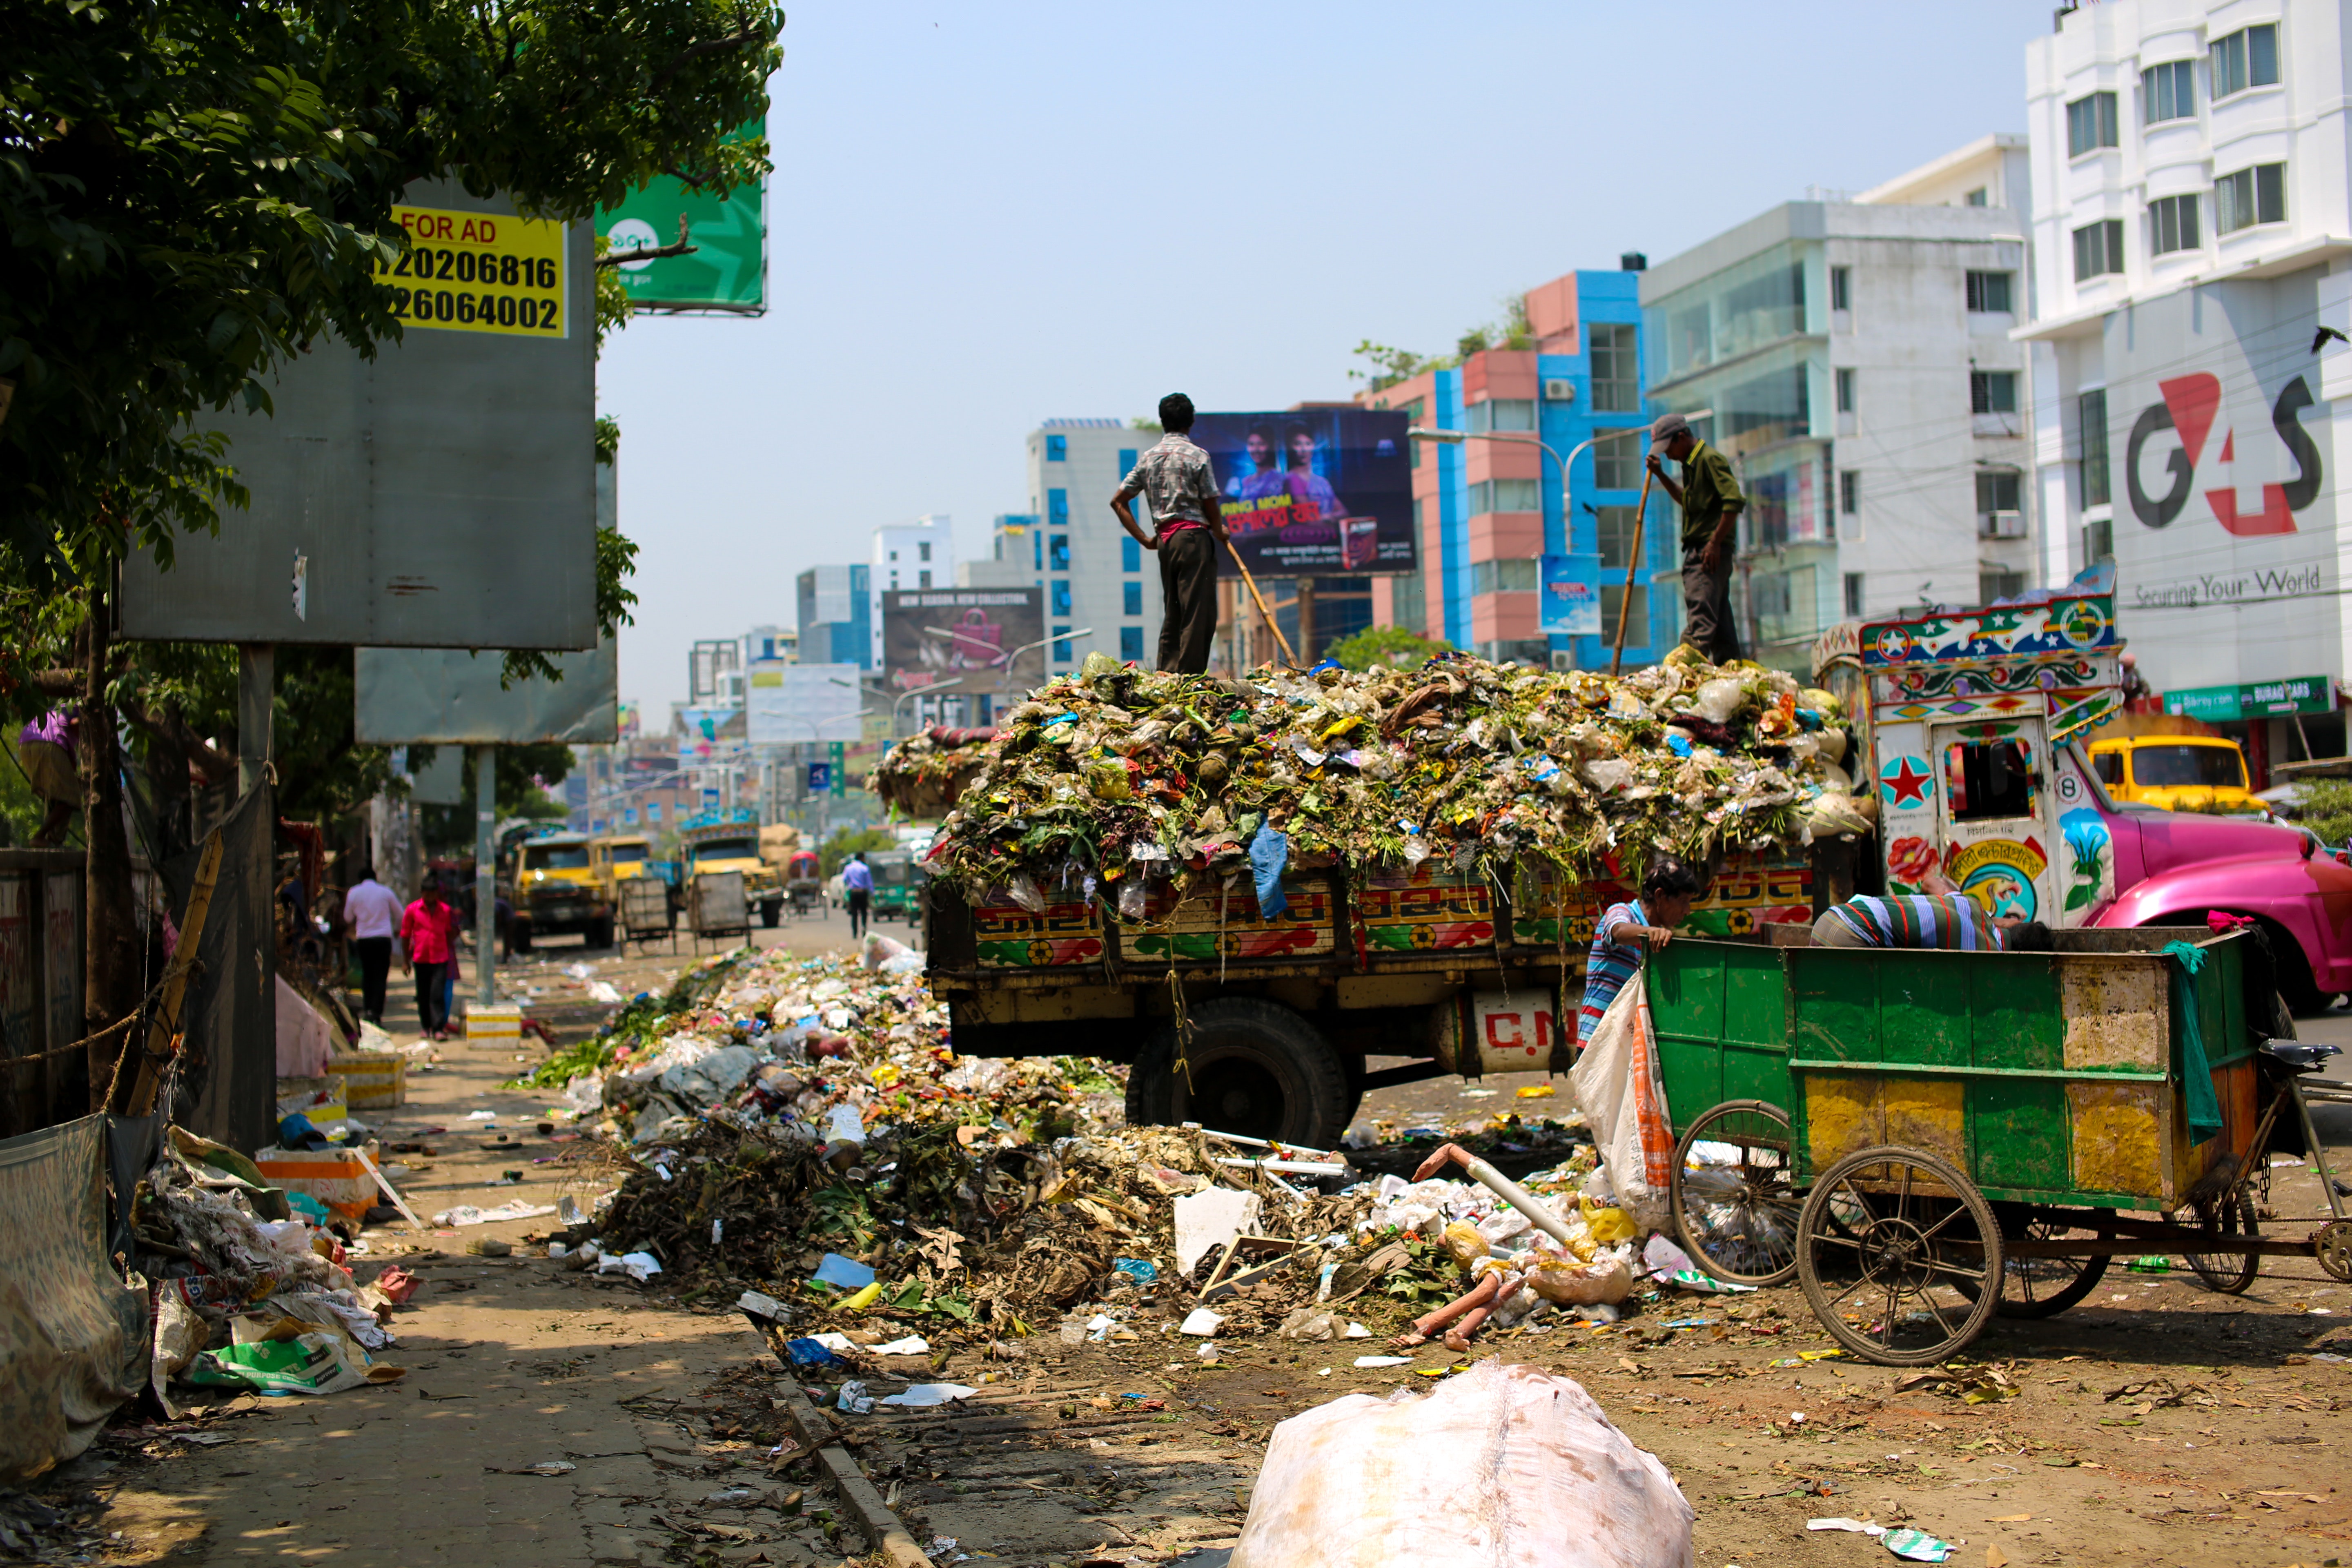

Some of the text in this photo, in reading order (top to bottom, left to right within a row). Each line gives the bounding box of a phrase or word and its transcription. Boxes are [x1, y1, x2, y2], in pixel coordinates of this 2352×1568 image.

[401, 212, 496, 243] FOR AD
[2126, 370, 2323, 537] G4S
[2135, 564, 2321, 608] Securing Your World
[247, 1372, 281, 1380] PURPOSE
[282, 1375, 311, 1386] CEMENT
[316, 1367, 336, 1383] Improved
